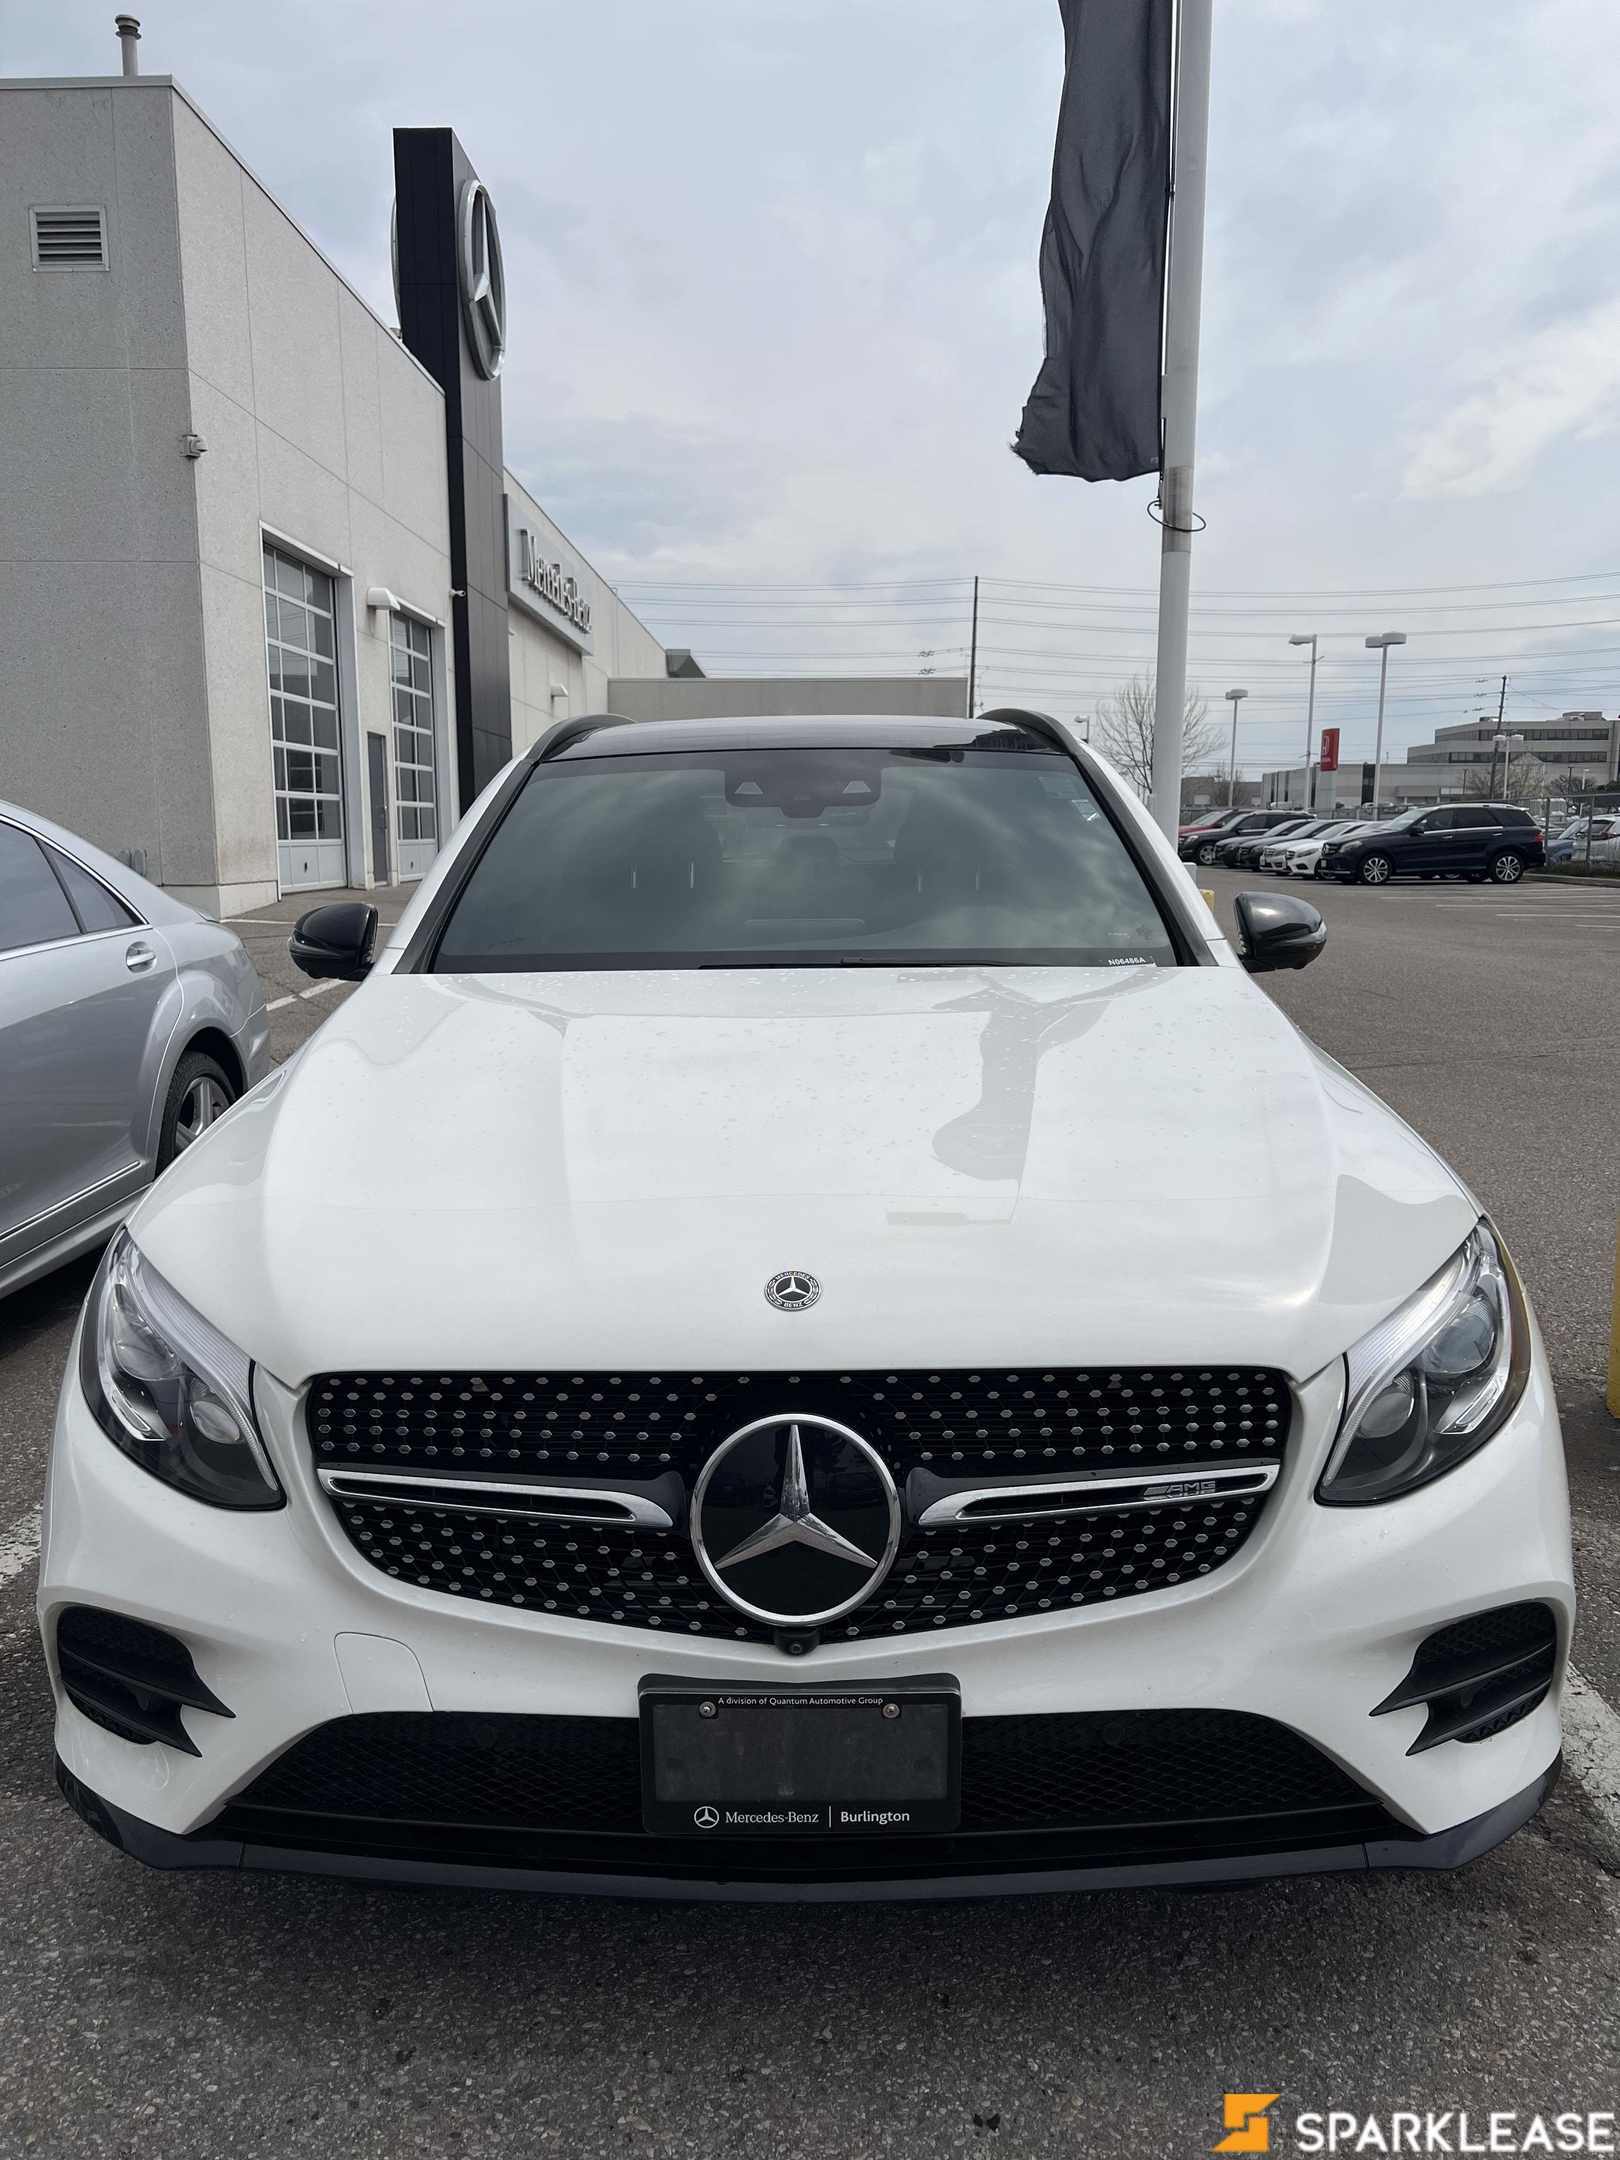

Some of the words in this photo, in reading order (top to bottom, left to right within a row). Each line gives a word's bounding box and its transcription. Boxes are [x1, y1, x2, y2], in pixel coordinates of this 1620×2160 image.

[1166, 1481, 1216, 1494] AMG
[718, 1697, 725, 1705] A
[726, 1696, 757, 1705] division
[758, 1696, 768, 1705] of
[769, 1697, 808, 1706] Quantum
[809, 1696, 857, 1705] Automotive
[858, 1696, 884, 1706] Group
[725, 1810, 819, 1824] Mercedes-Benz
[840, 1810, 911, 1825] Burlington
